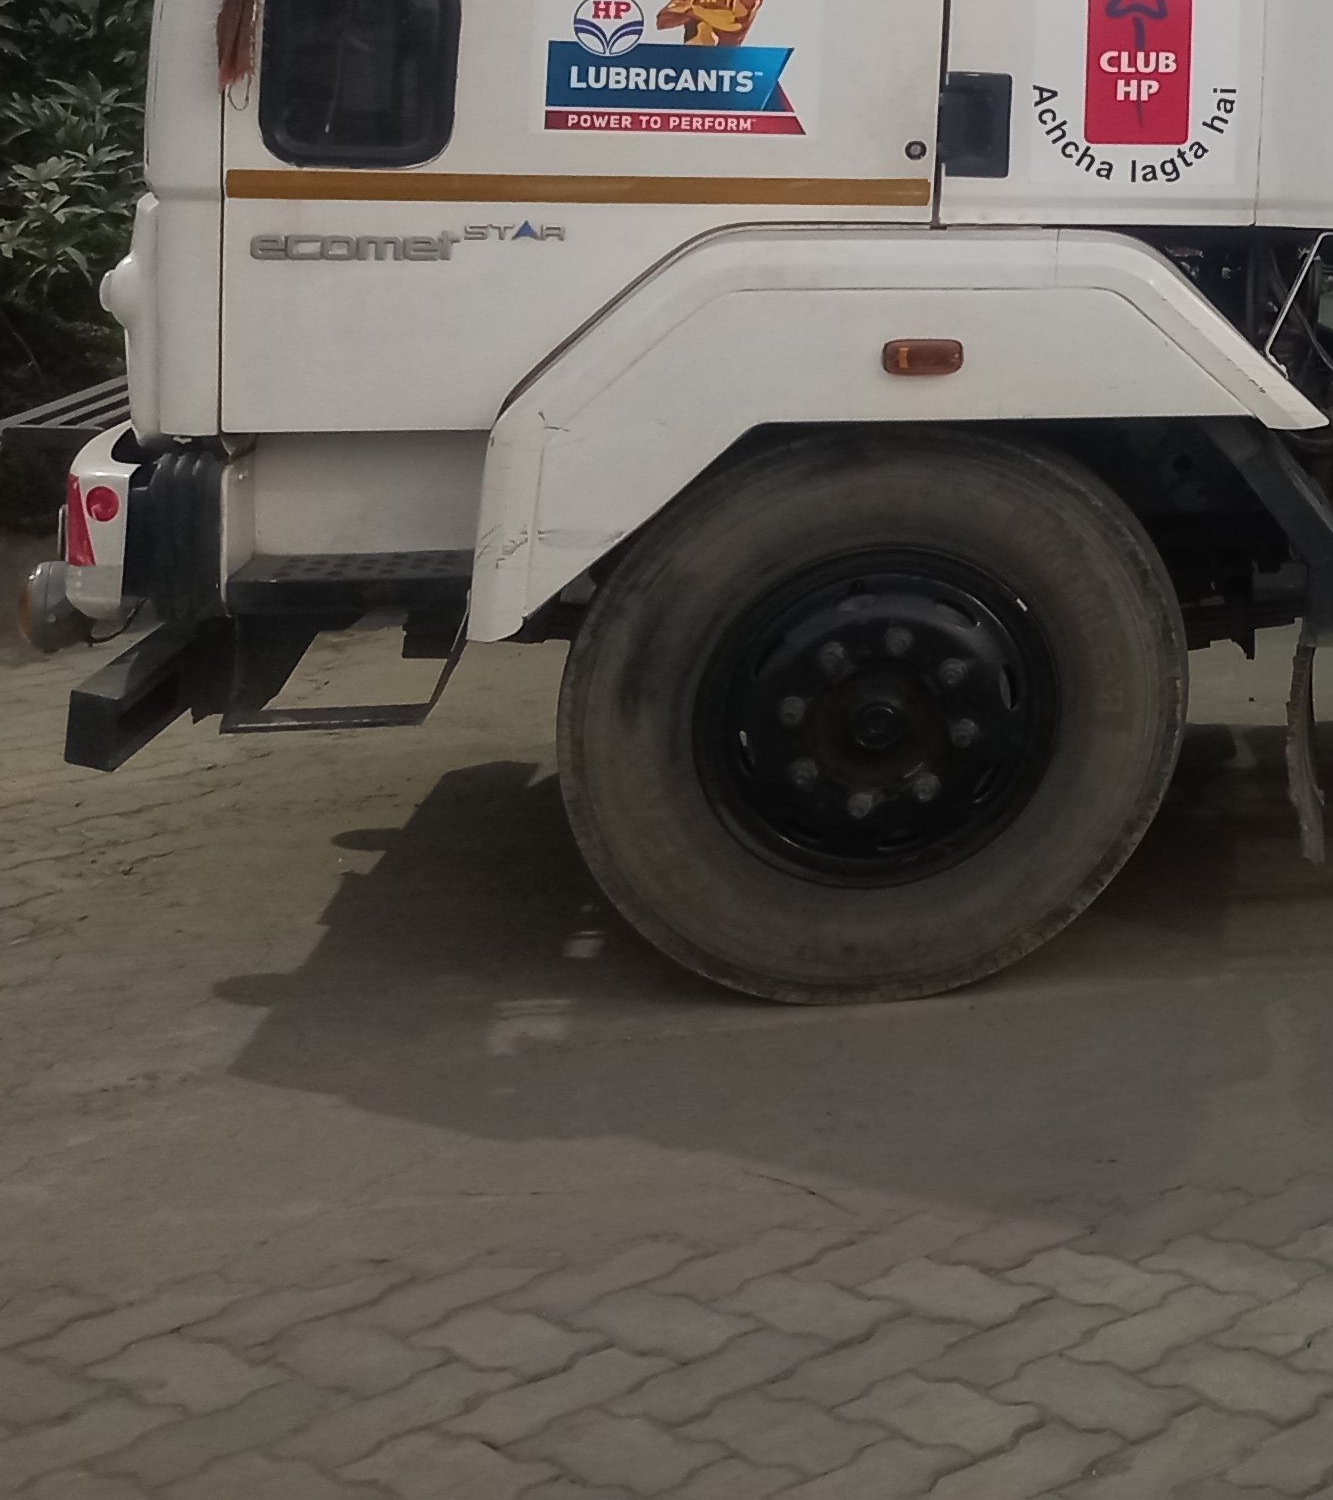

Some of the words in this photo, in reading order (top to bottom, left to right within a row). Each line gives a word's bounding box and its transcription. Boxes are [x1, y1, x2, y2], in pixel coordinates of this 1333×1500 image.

[591, 0, 631, 20] HP
[1099, 50, 1177, 74] CLUB
[569, 65, 754, 93] LUBRICANTS
[1116, 79, 1160, 102] HP
[567, 114, 632, 129] POWER
[639, 115, 662, 129] TO
[669, 116, 752, 131] PERFORM
[1032, 84, 1114, 180] Achcha
[1130, 141, 1209, 182] lagta
[1202, 87, 1237, 134] hai
[250, 230, 461, 262] ecomet
[463, 219, 566, 242] STAR
